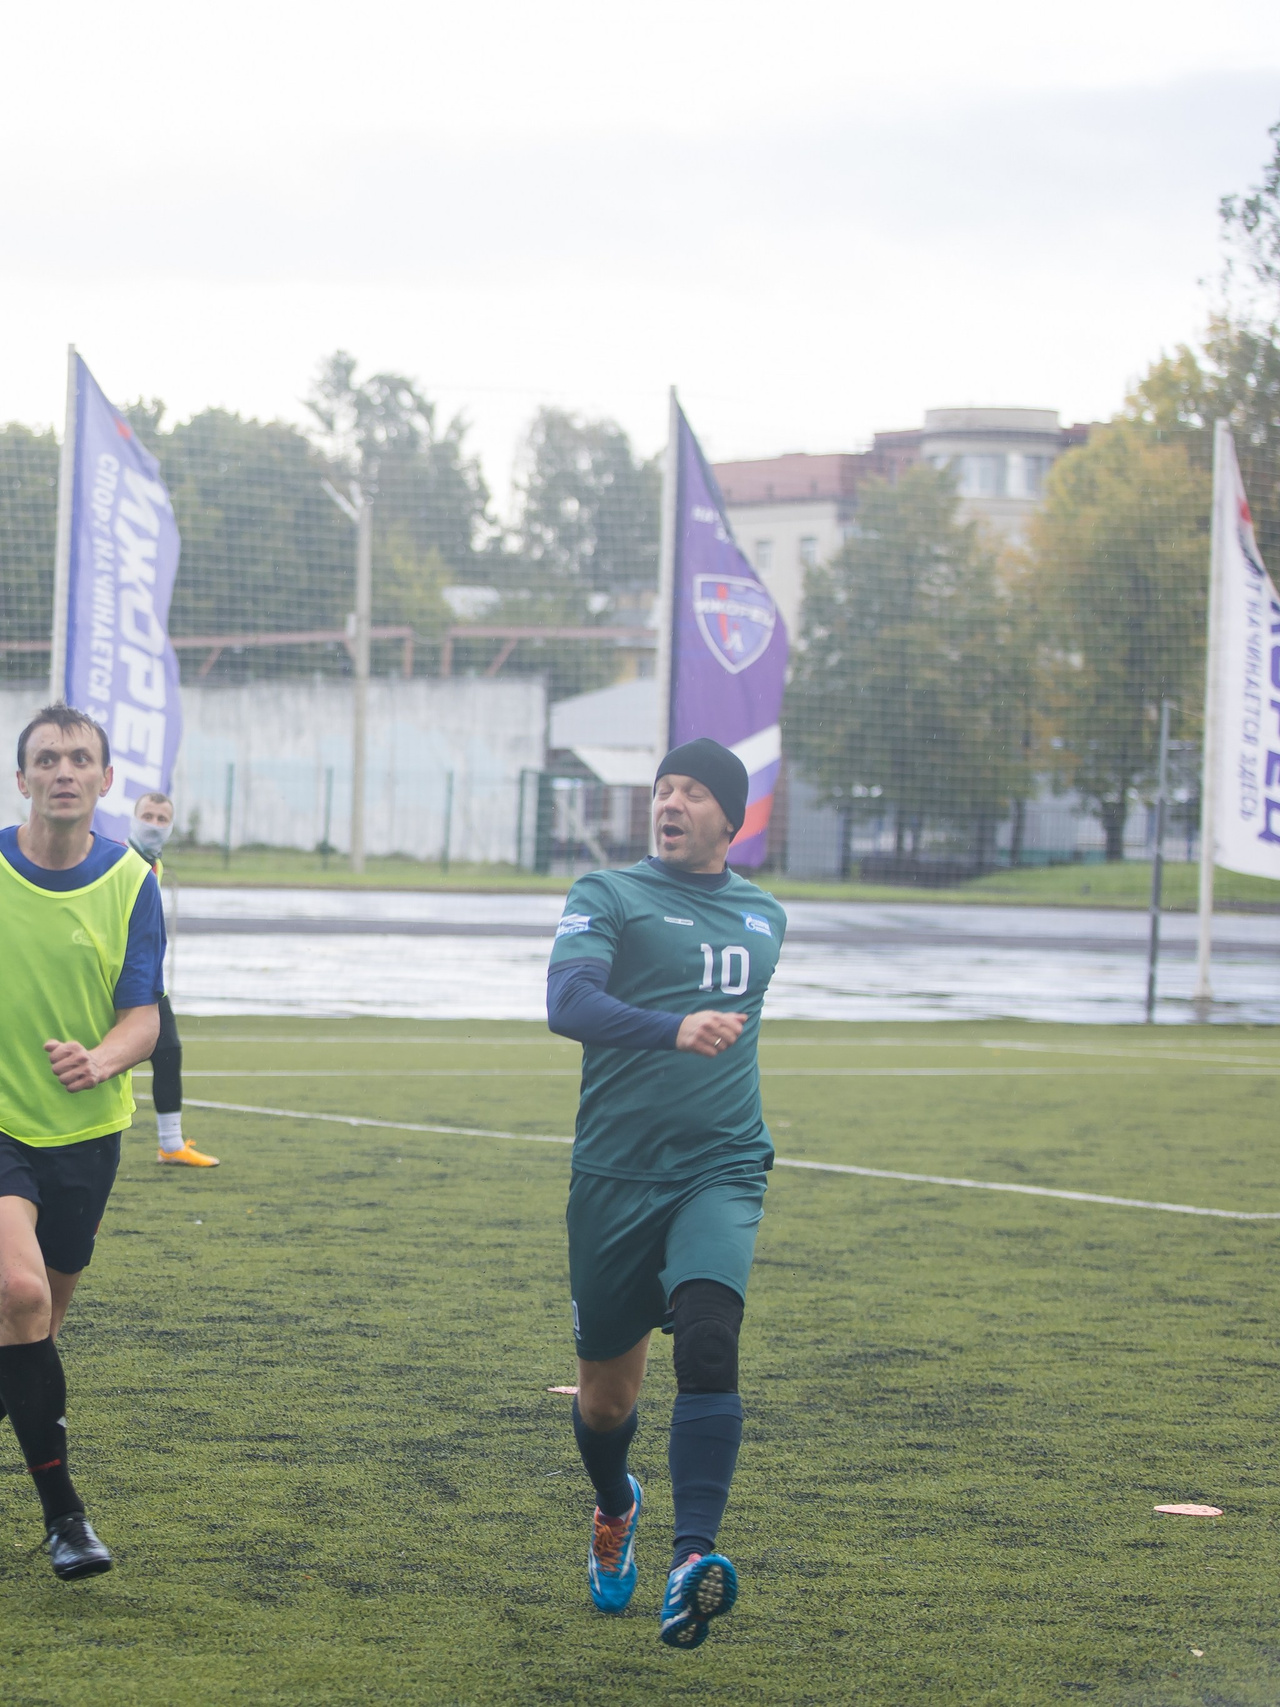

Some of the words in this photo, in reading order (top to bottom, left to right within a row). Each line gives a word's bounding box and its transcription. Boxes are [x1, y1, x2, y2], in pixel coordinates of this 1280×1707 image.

[90, 452, 120, 536] СПОРТ
[88, 537, 115, 703] НАЧИНАЕТСЯ
[698, 943, 750, 996] 10
